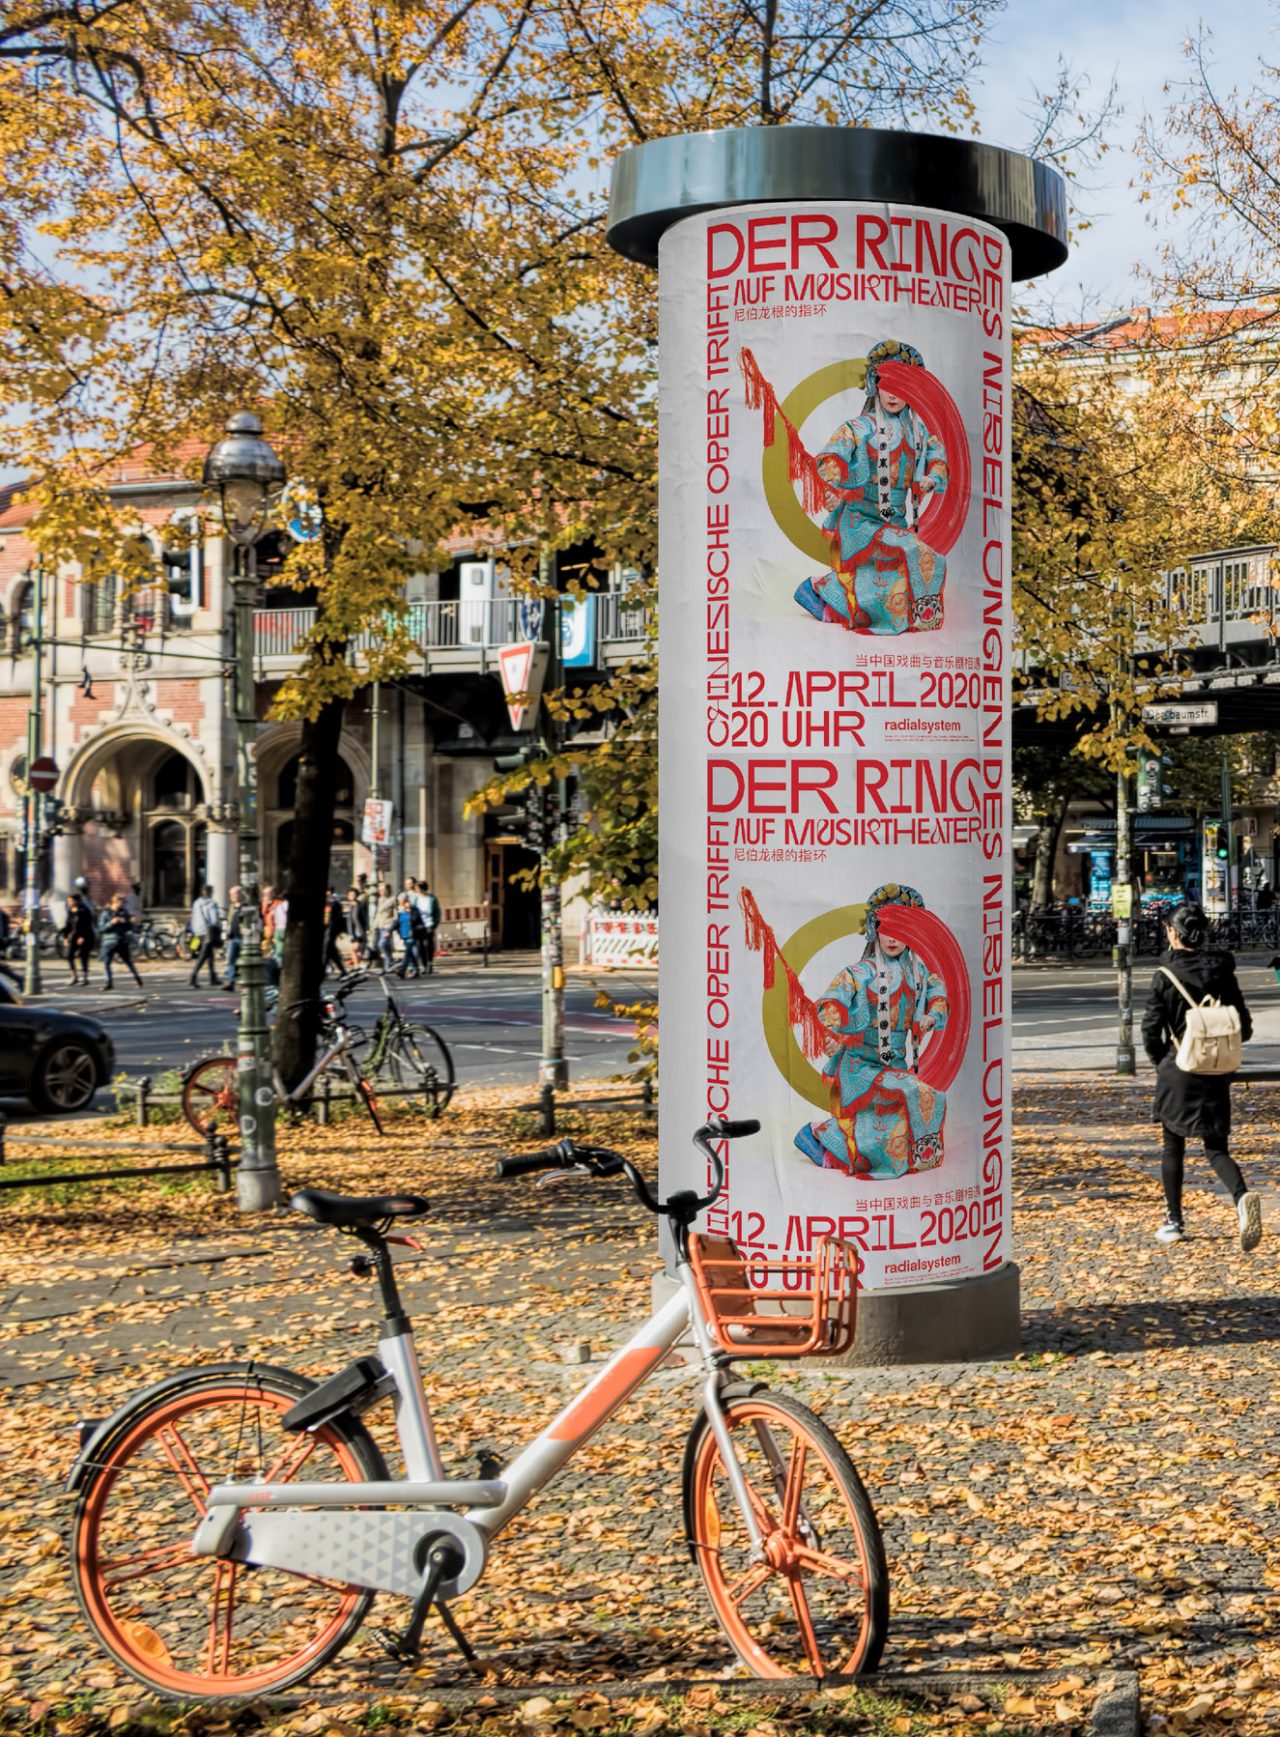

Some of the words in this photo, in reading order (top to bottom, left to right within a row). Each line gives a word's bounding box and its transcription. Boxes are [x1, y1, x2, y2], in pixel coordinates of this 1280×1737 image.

[707, 214, 839, 280] DER
[856, 214, 981, 284] RING
[733, 303, 828, 322] 尼伯龙根的指环
[734, 275, 775, 306] AUF
[784, 273, 982, 315] MUSIKTHEATER
[983, 235, 1003, 341] DES
[707, 283, 729, 381] TRIFFT
[707, 388, 729, 494] OPER
[983, 352, 1003, 747] NIBELUNGEN
[731, 671, 778, 708] 12.
[785, 671, 917, 708] APRIL
[920, 672, 981, 709] 2020
[1146, 707, 1209, 720] Obebaumstr.
[731, 710, 769, 748] 20
[782, 710, 865, 747] UHR
[884, 718, 961, 734] radialsystem
[707, 759, 839, 814] DER
[856, 758, 981, 814] RING
[983, 759, 1003, 860] DES
[734, 818, 775, 845] AUF
[784, 817, 982, 846] MUSIKTHEATER
[734, 848, 828, 862] 尼伯龙根的指环
[707, 816, 729, 914] TRIFFT
[707, 923, 729, 1029] OPER
[983, 874, 1003, 1271] NIBELUNGEN
[707, 1038, 729, 1236] INESCHE
[731, 1210, 778, 1250] 12.
[785, 1214, 917, 1252] APRIL
[920, 1201, 981, 1247] 2020
[884, 1255, 961, 1274] radialsystem
